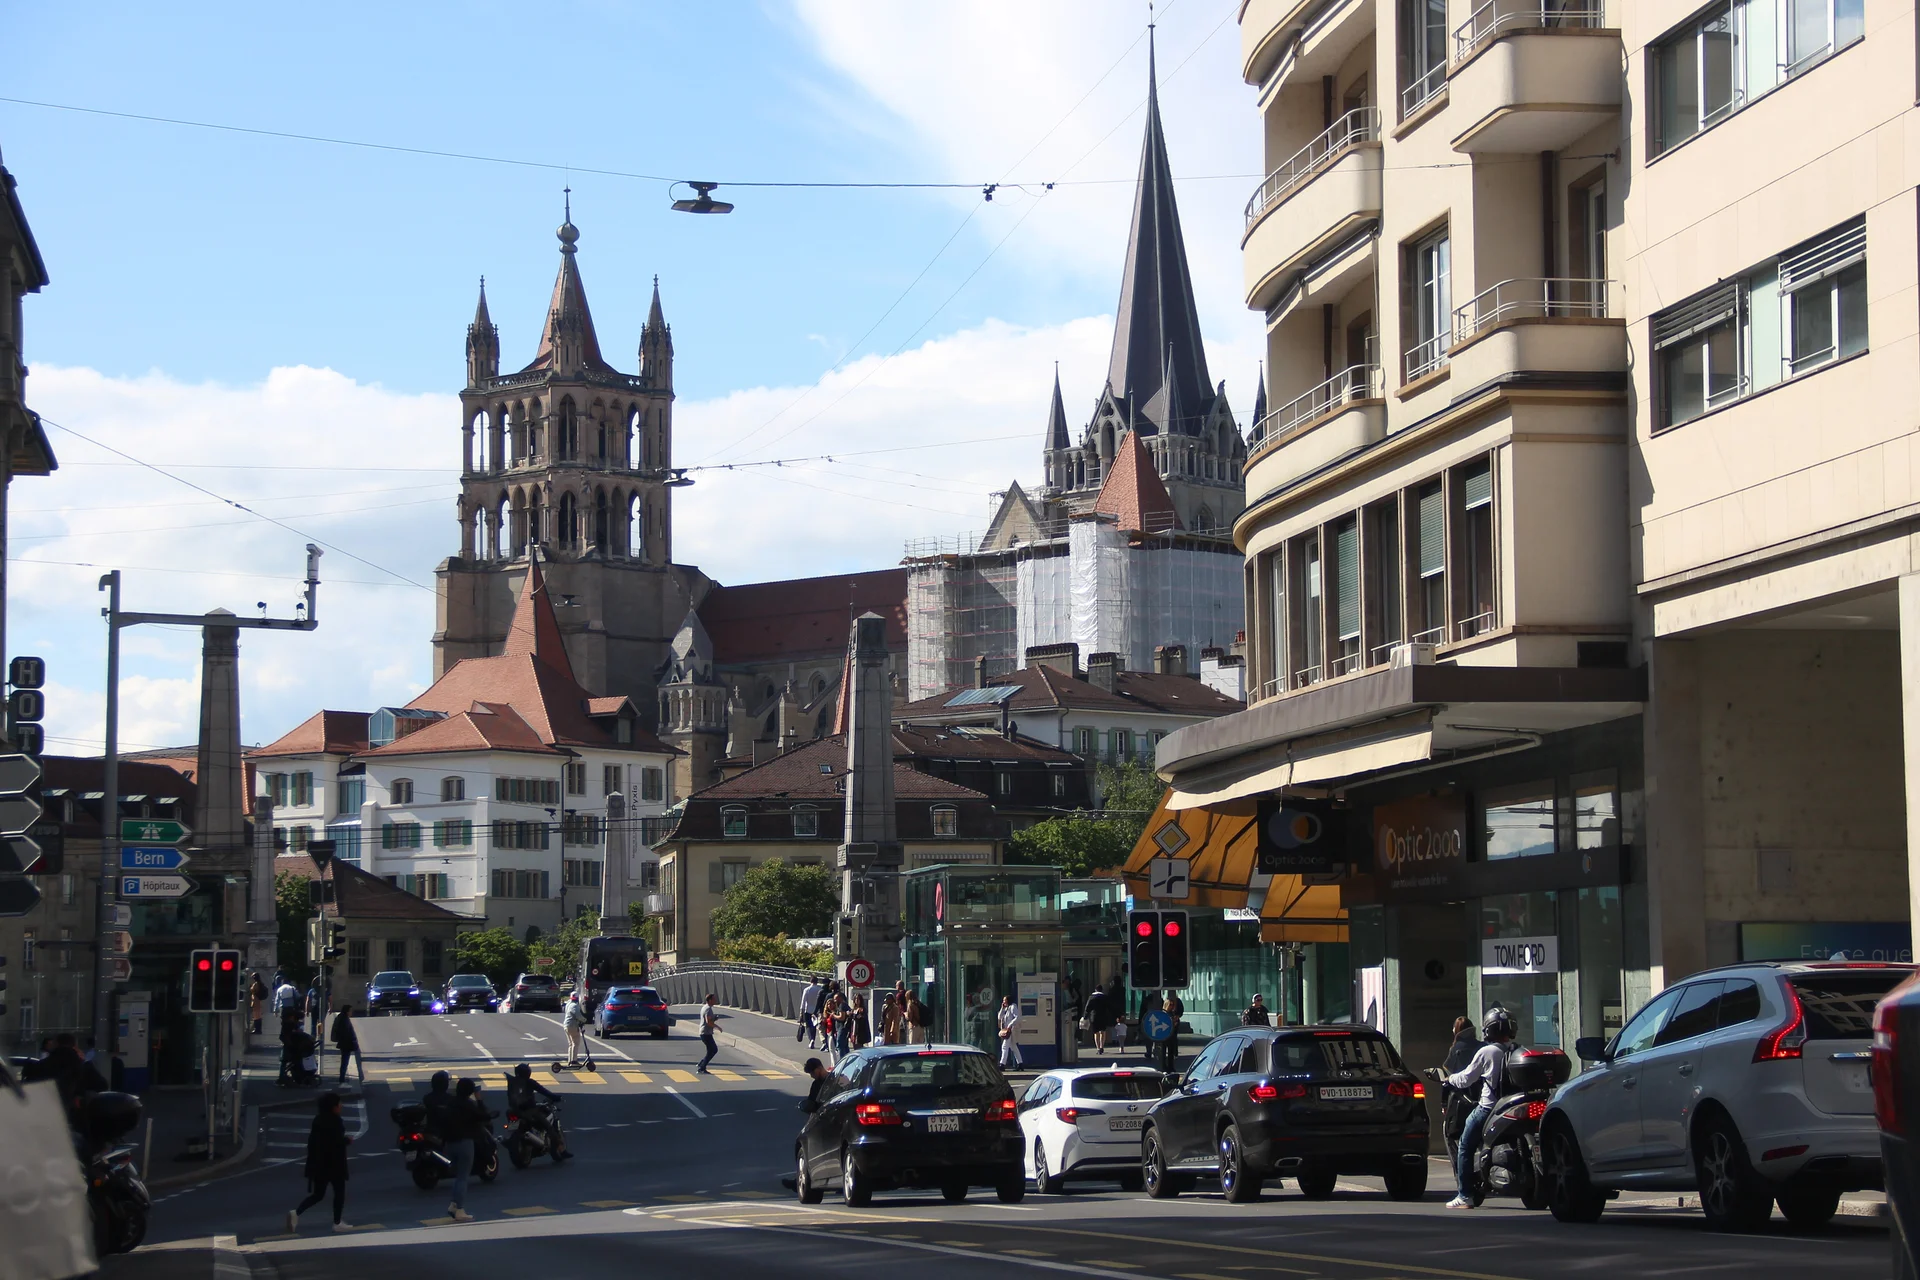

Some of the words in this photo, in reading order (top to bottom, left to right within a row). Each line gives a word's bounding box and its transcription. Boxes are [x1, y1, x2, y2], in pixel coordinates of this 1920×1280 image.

[1385, 825, 1424, 875] Optic
[1425, 826, 1461, 859] 2000
[135, 851, 165, 865] Bern
[1265, 854, 1296, 869] Optic
[143, 881, 180, 892] Hôpitaux
[1494, 944, 1516, 967] TOM
[1517, 943, 1545, 967] FORD
[855, 968, 866, 979] 30
